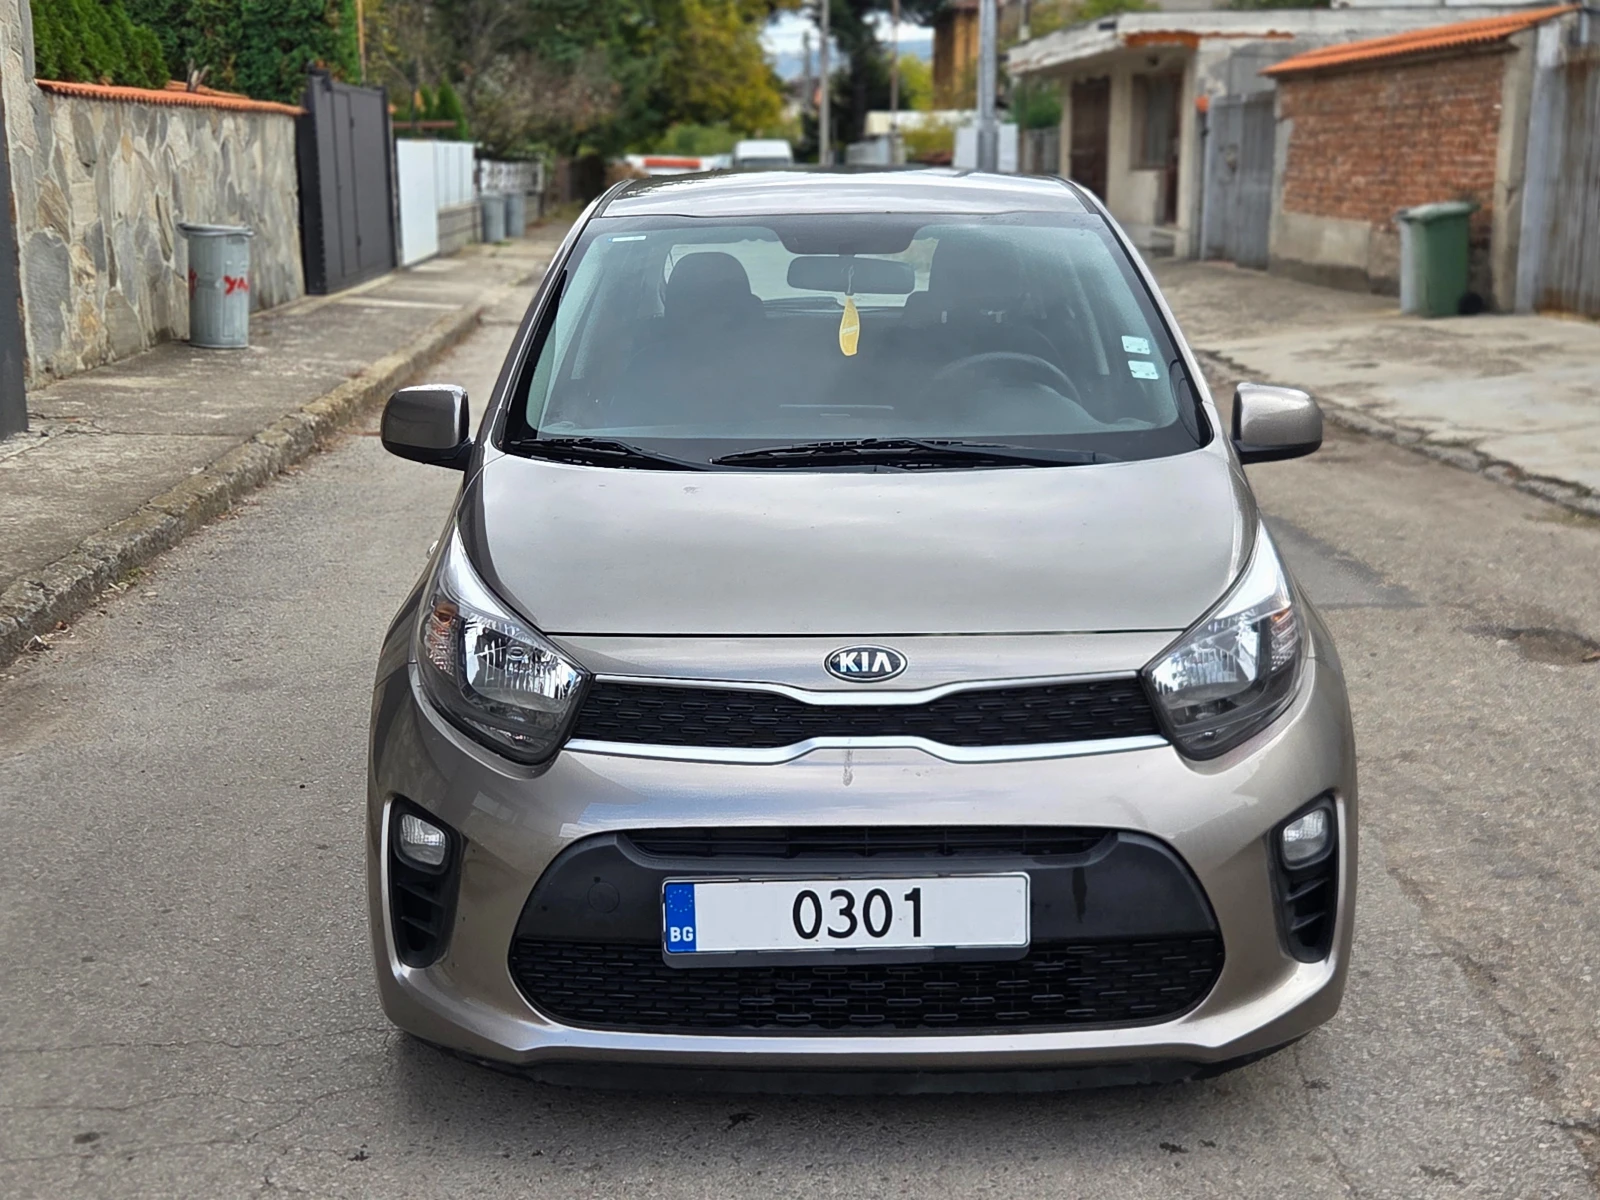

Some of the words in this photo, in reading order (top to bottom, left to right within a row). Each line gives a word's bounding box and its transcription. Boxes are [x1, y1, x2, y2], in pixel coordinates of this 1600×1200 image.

[839, 651, 893, 673] KIA
[792, 887, 922, 940] 0301
[670, 926, 694, 942] BG
